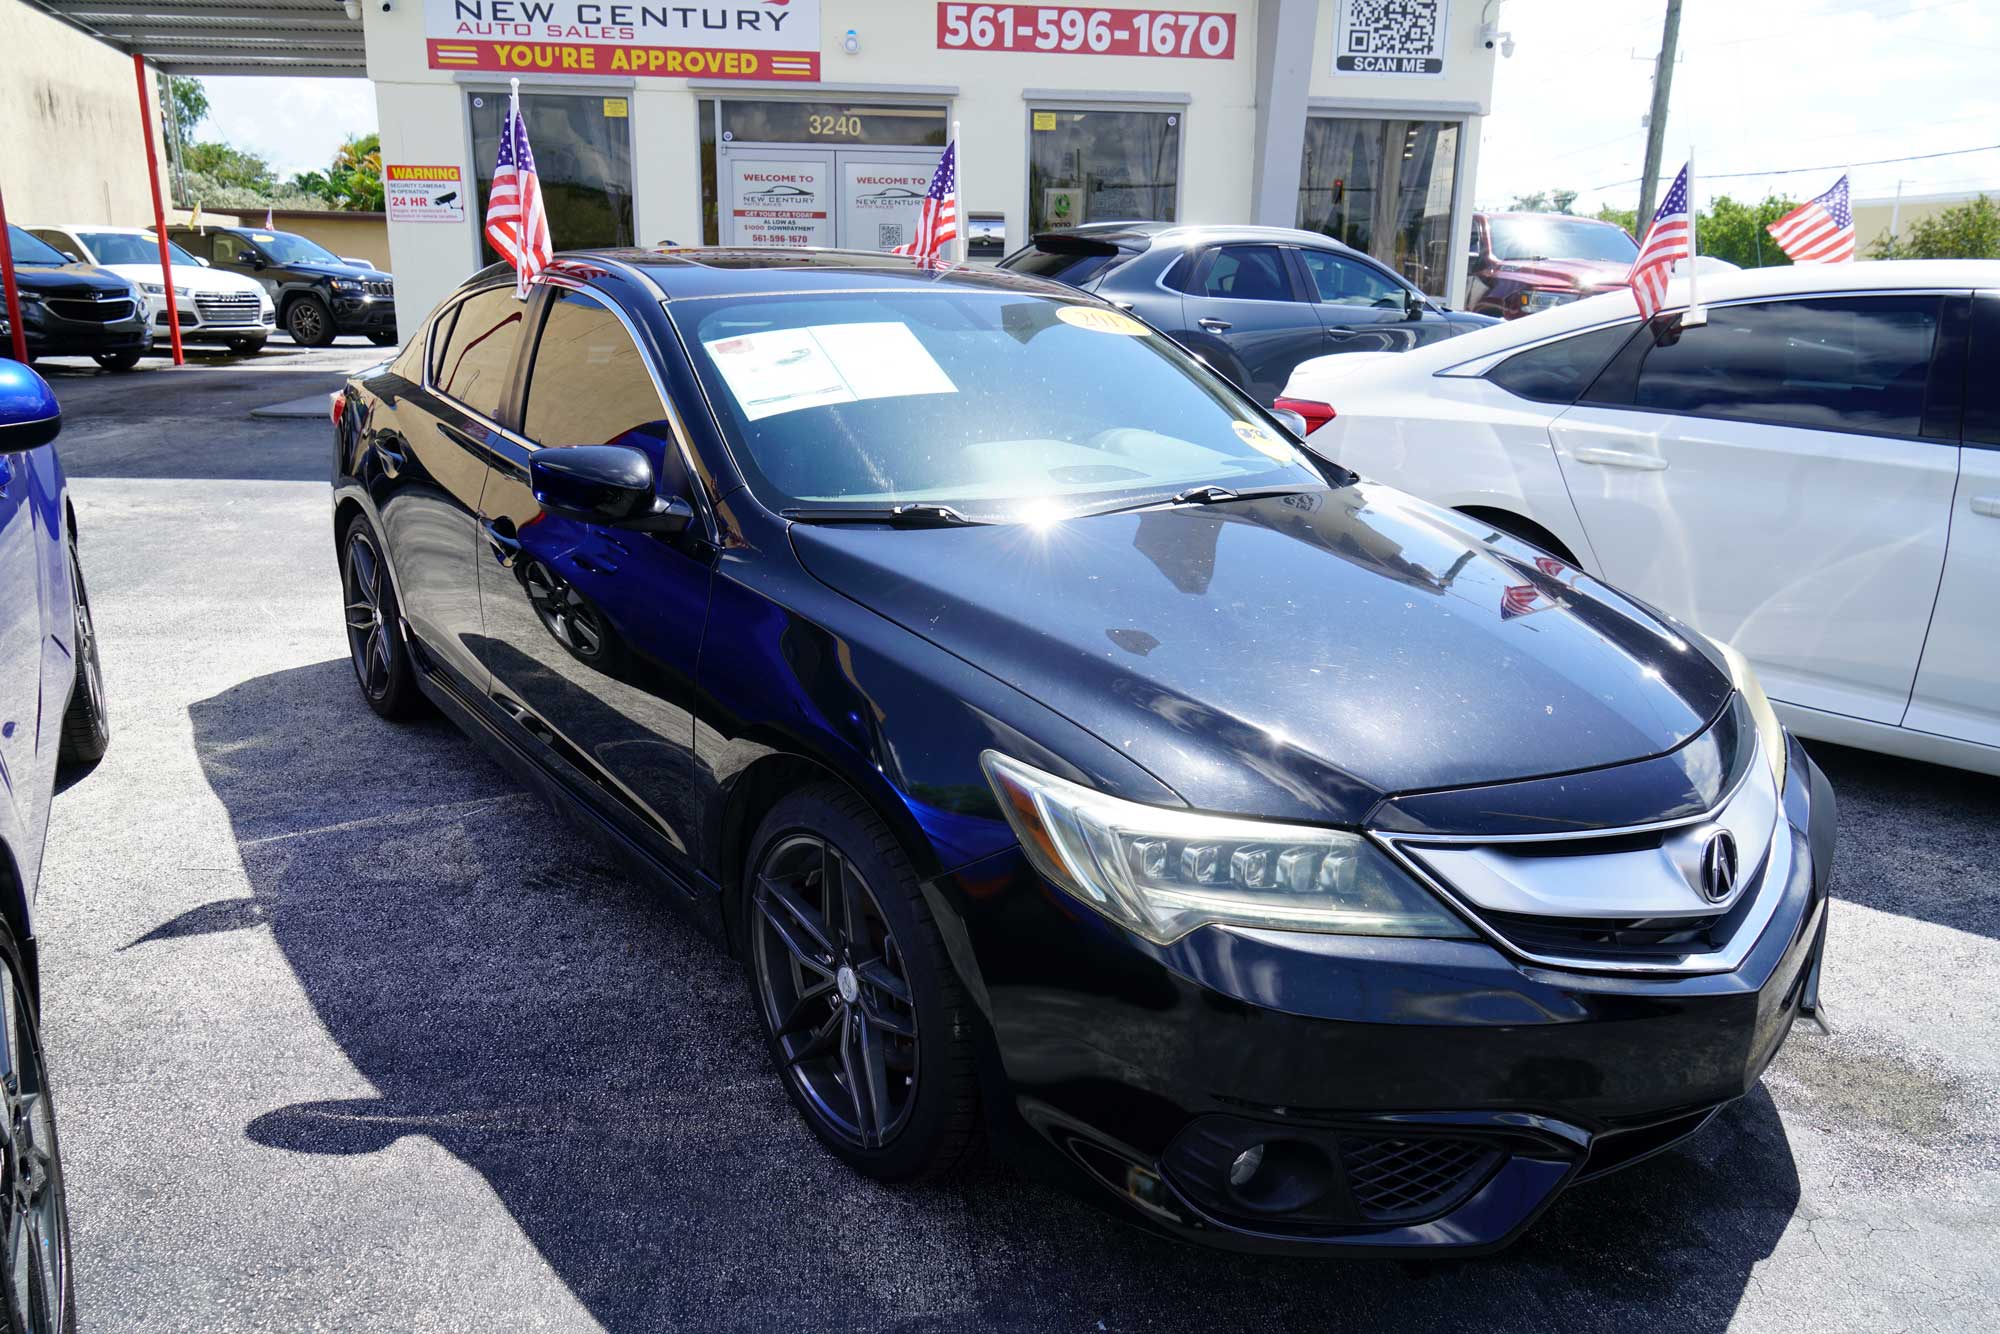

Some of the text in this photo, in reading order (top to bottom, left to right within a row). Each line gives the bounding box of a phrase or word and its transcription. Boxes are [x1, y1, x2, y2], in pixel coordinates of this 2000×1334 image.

[455, 0, 789, 31] NEW CENTURY
[456, 22, 634, 39] AUTO SALES
[944, 5, 1229, 56] 561-596-1670
[493, 44, 758, 74] YOU'RE APPROVED
[1353, 57, 1426, 72] SCAN ME
[809, 115, 861, 136] 3240
[391, 167, 458, 180] WARNING
[743, 174, 796, 182] WELCOME
[392, 196, 427, 207] 24 HR
[752, 234, 808, 243] 561-596-1670
